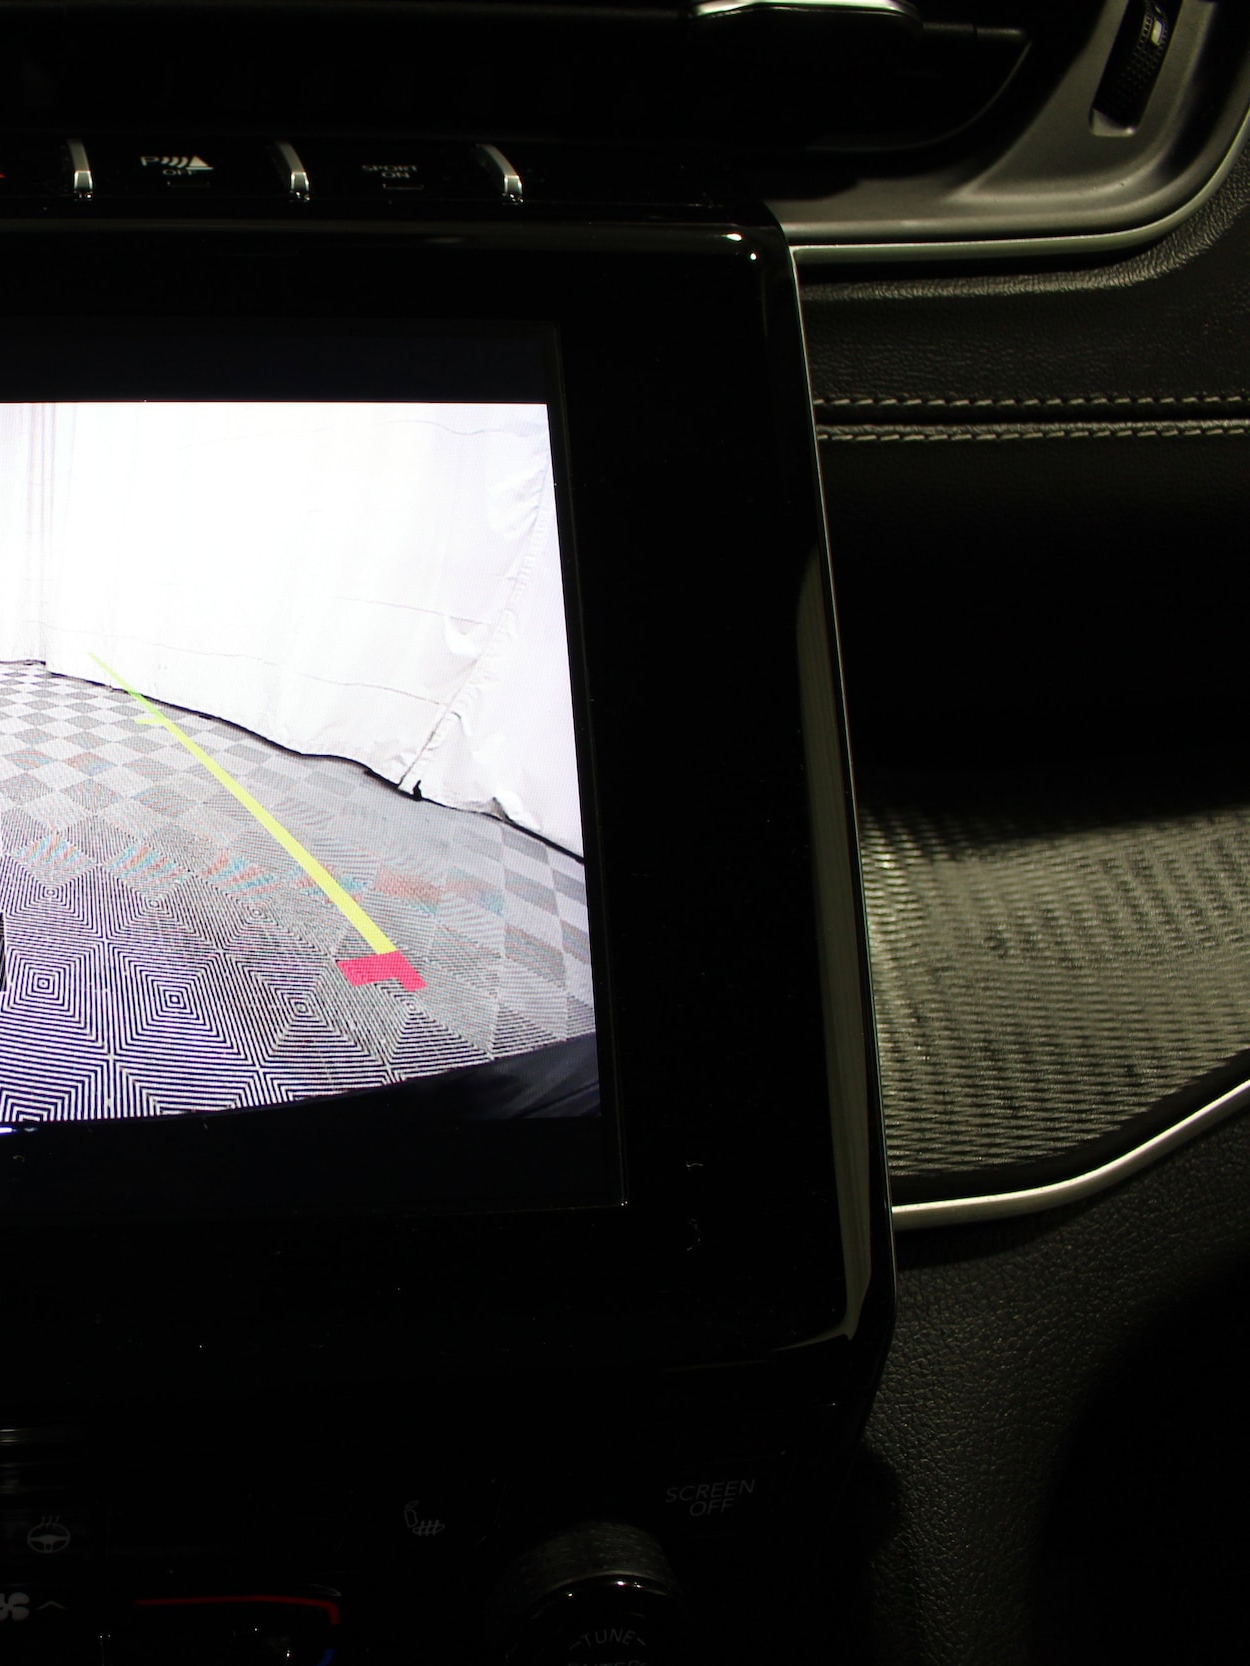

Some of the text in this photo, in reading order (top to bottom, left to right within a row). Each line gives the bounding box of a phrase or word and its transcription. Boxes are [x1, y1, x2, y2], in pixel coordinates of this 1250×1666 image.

[381, 171, 411, 179] ON
[664, 1477, 758, 1504] SCREEN
[688, 1497, 735, 1517] OFF
[579, 1628, 636, 1648] TUNE
